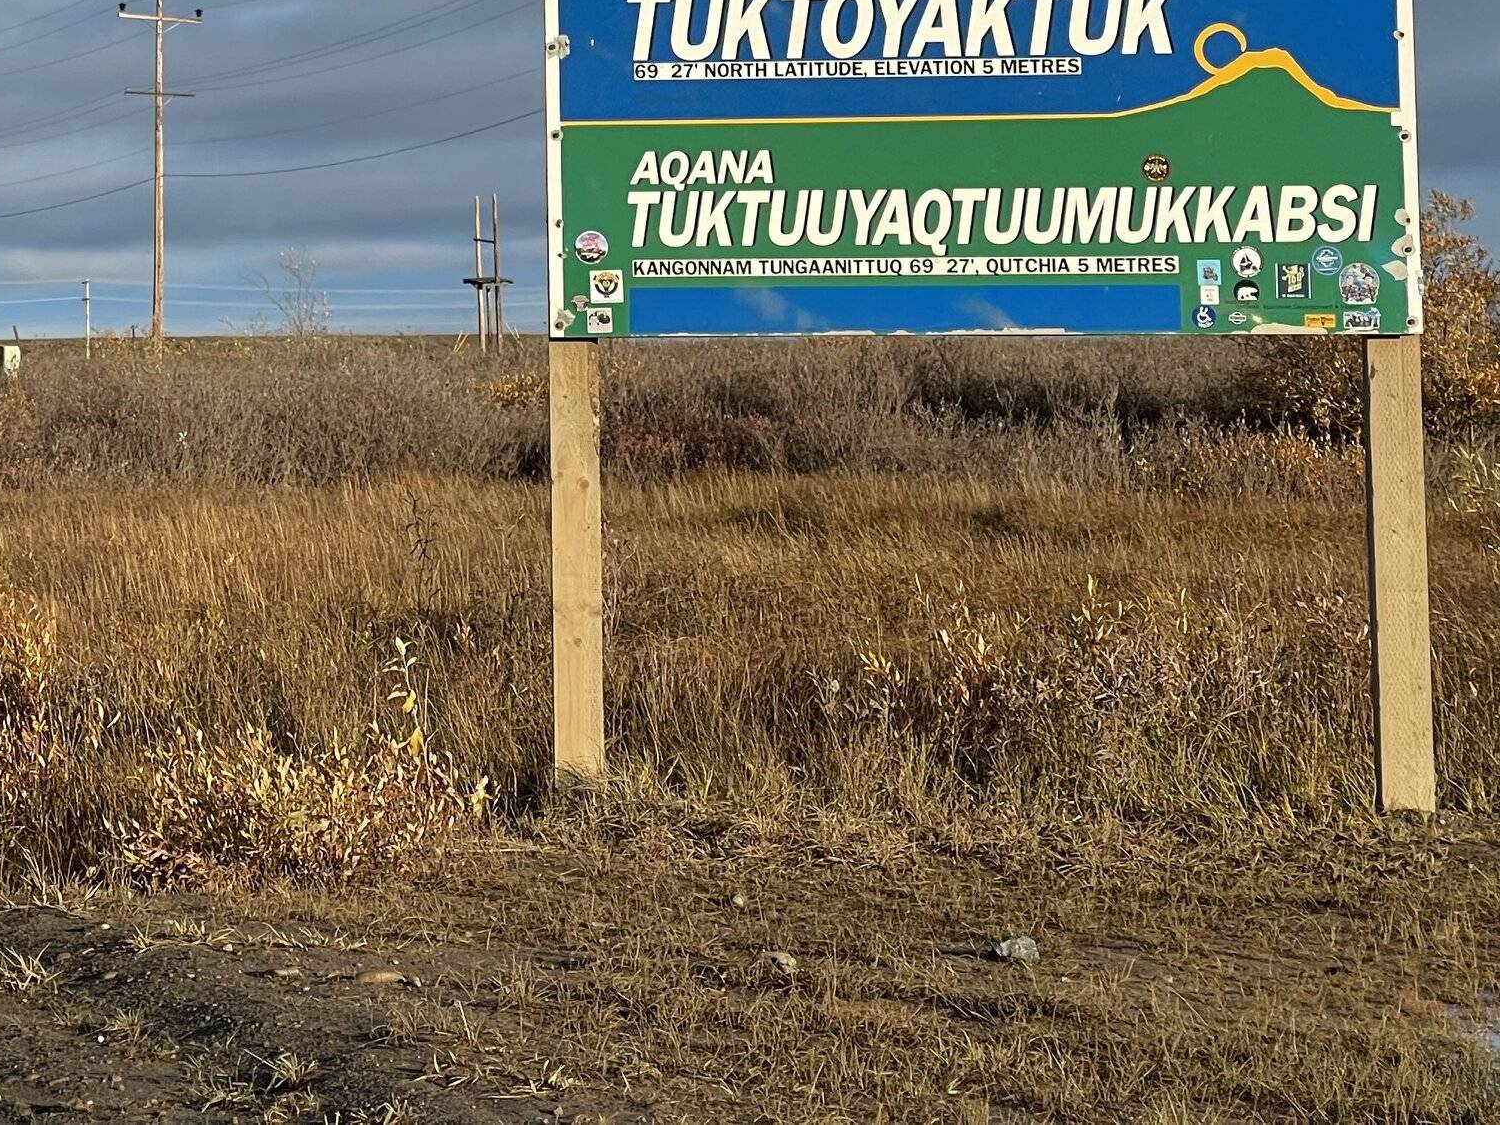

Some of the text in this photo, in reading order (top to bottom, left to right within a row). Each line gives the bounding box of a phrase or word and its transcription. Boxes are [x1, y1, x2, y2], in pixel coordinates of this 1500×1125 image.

[671, 63, 699, 78] 27'
[704, 63, 767, 78] NORTH
[774, 61, 868, 78] LATITUDE,
[874, 59, 975, 77] ELEVATION
[982, 59, 994, 75] 5
[1000, 58, 1080, 74] METRES
[629, 149, 774, 191] AQANA
[627, 184, 1378, 257] TUKTUUYAQTUUMUKKABSI
[633, 260, 751, 276] KANGONNAM
[758, 258, 902, 276] TUNGAANITTUQ
[946, 258, 980, 275] 27',
[986, 258, 1070, 275] QUTCHIA
[1077, 258, 1090, 273] 5
[1096, 257, 1177, 273] METRES
